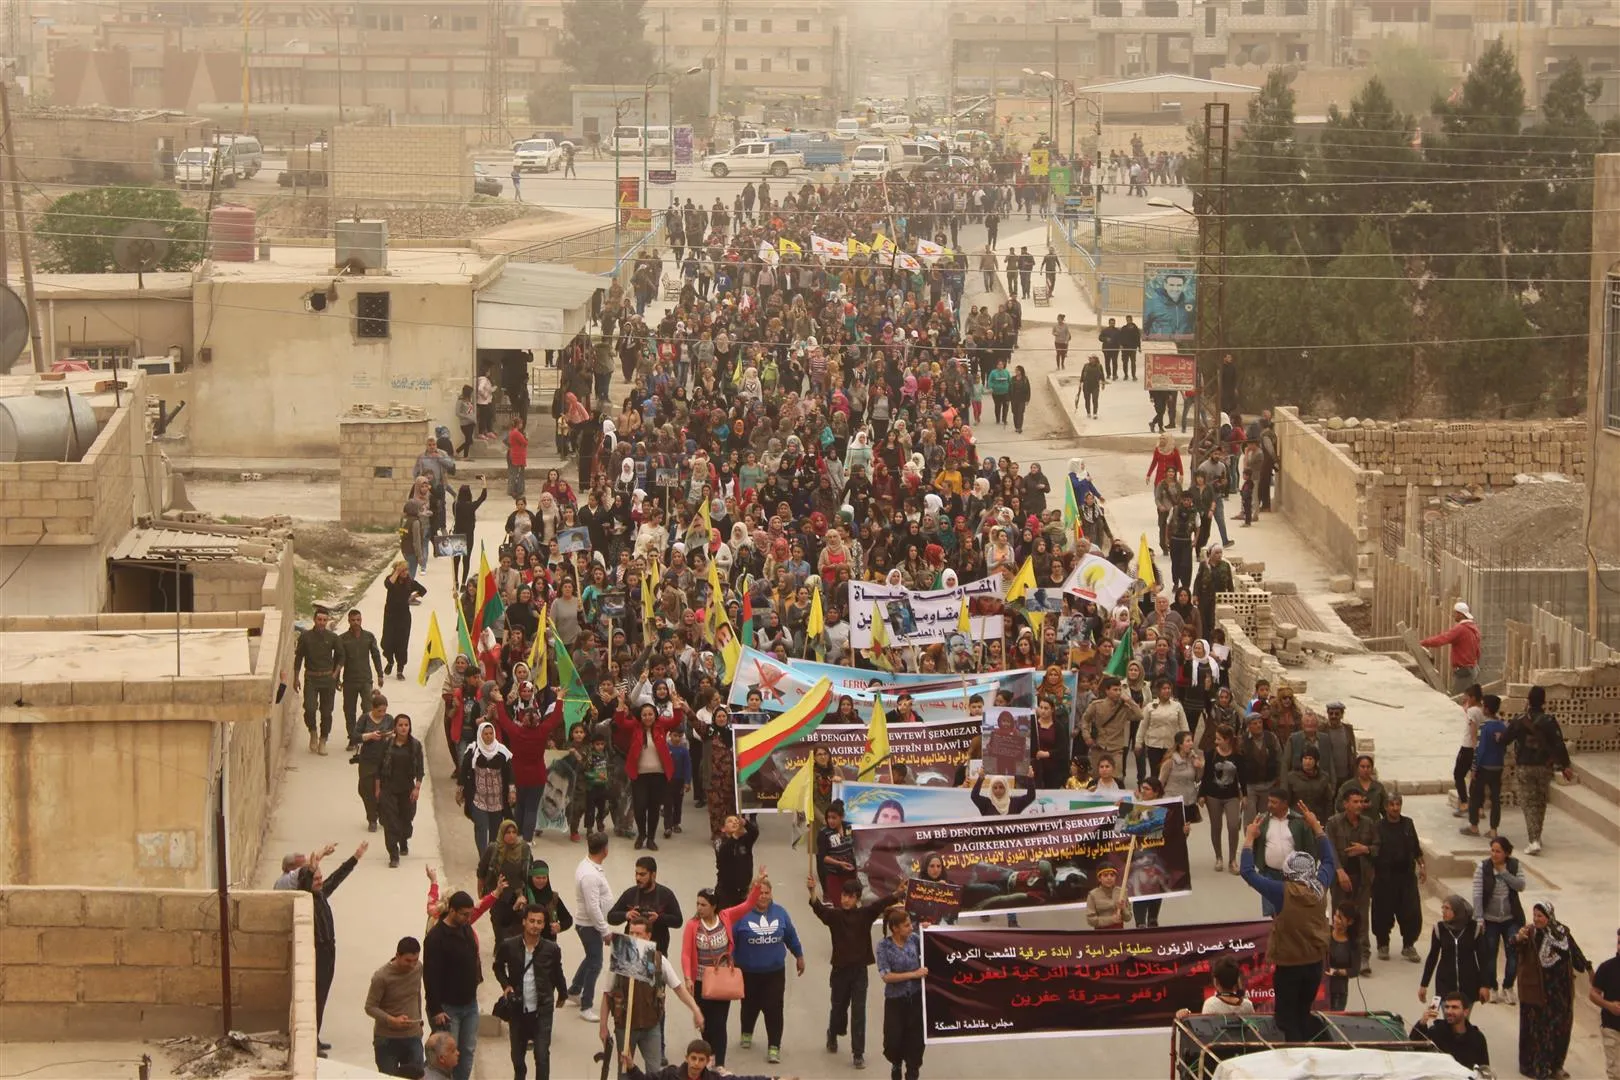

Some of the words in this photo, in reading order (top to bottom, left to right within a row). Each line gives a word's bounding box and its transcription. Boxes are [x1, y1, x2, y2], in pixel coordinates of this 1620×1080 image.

[807, 731, 819, 742] BÊ
[821, 732, 860, 742] DENGIYA
[928, 726, 978, 740] ŞERMEZAR
[889, 743, 921, 753] EFFRÎN
[924, 742, 934, 751] BI
[936, 738, 961, 750] DAWÎ
[916, 830, 931, 841] EM
[934, 828, 948, 839] BÊ
[950, 825, 995, 838] DENGIYA
[996, 819, 1063, 834] NAVNEWTEWÎ
[954, 839, 1022, 852] DAGIRKERIYA
[1025, 834, 1060, 847] EFFRÎN
[1062, 833, 1073, 843] BI
[1075, 829, 1101, 842] DAWÎ
[984, 946, 1016, 959] للشعب
[1018, 946, 1048, 960] عرقية
[1051, 946, 1072, 958] ابادة
[1085, 942, 1123, 958] أجرامية
[1126, 942, 1153, 956] عملية
[1157, 940, 1194, 956] الزيتون
[1197, 941, 1225, 954] غصن
[1228, 938, 1256, 952] عملية
[946, 948, 981, 964] الكردي
[1076, 950, 1083, 959] و
[952, 964, 1007, 985] لعفرين
[1011, 963, 1068, 981] التركية
[1073, 962, 1120, 980] الدولة
[1126, 961, 1179, 978] احتلال
[1011, 990, 1061, 1007] عفرين
[1068, 987, 1120, 1004] محرقة
[934, 1020, 961, 1031] الحسكة
[963, 1019, 989, 1030] مقاطعة
[991, 1018, 1014, 1030] مجلس
